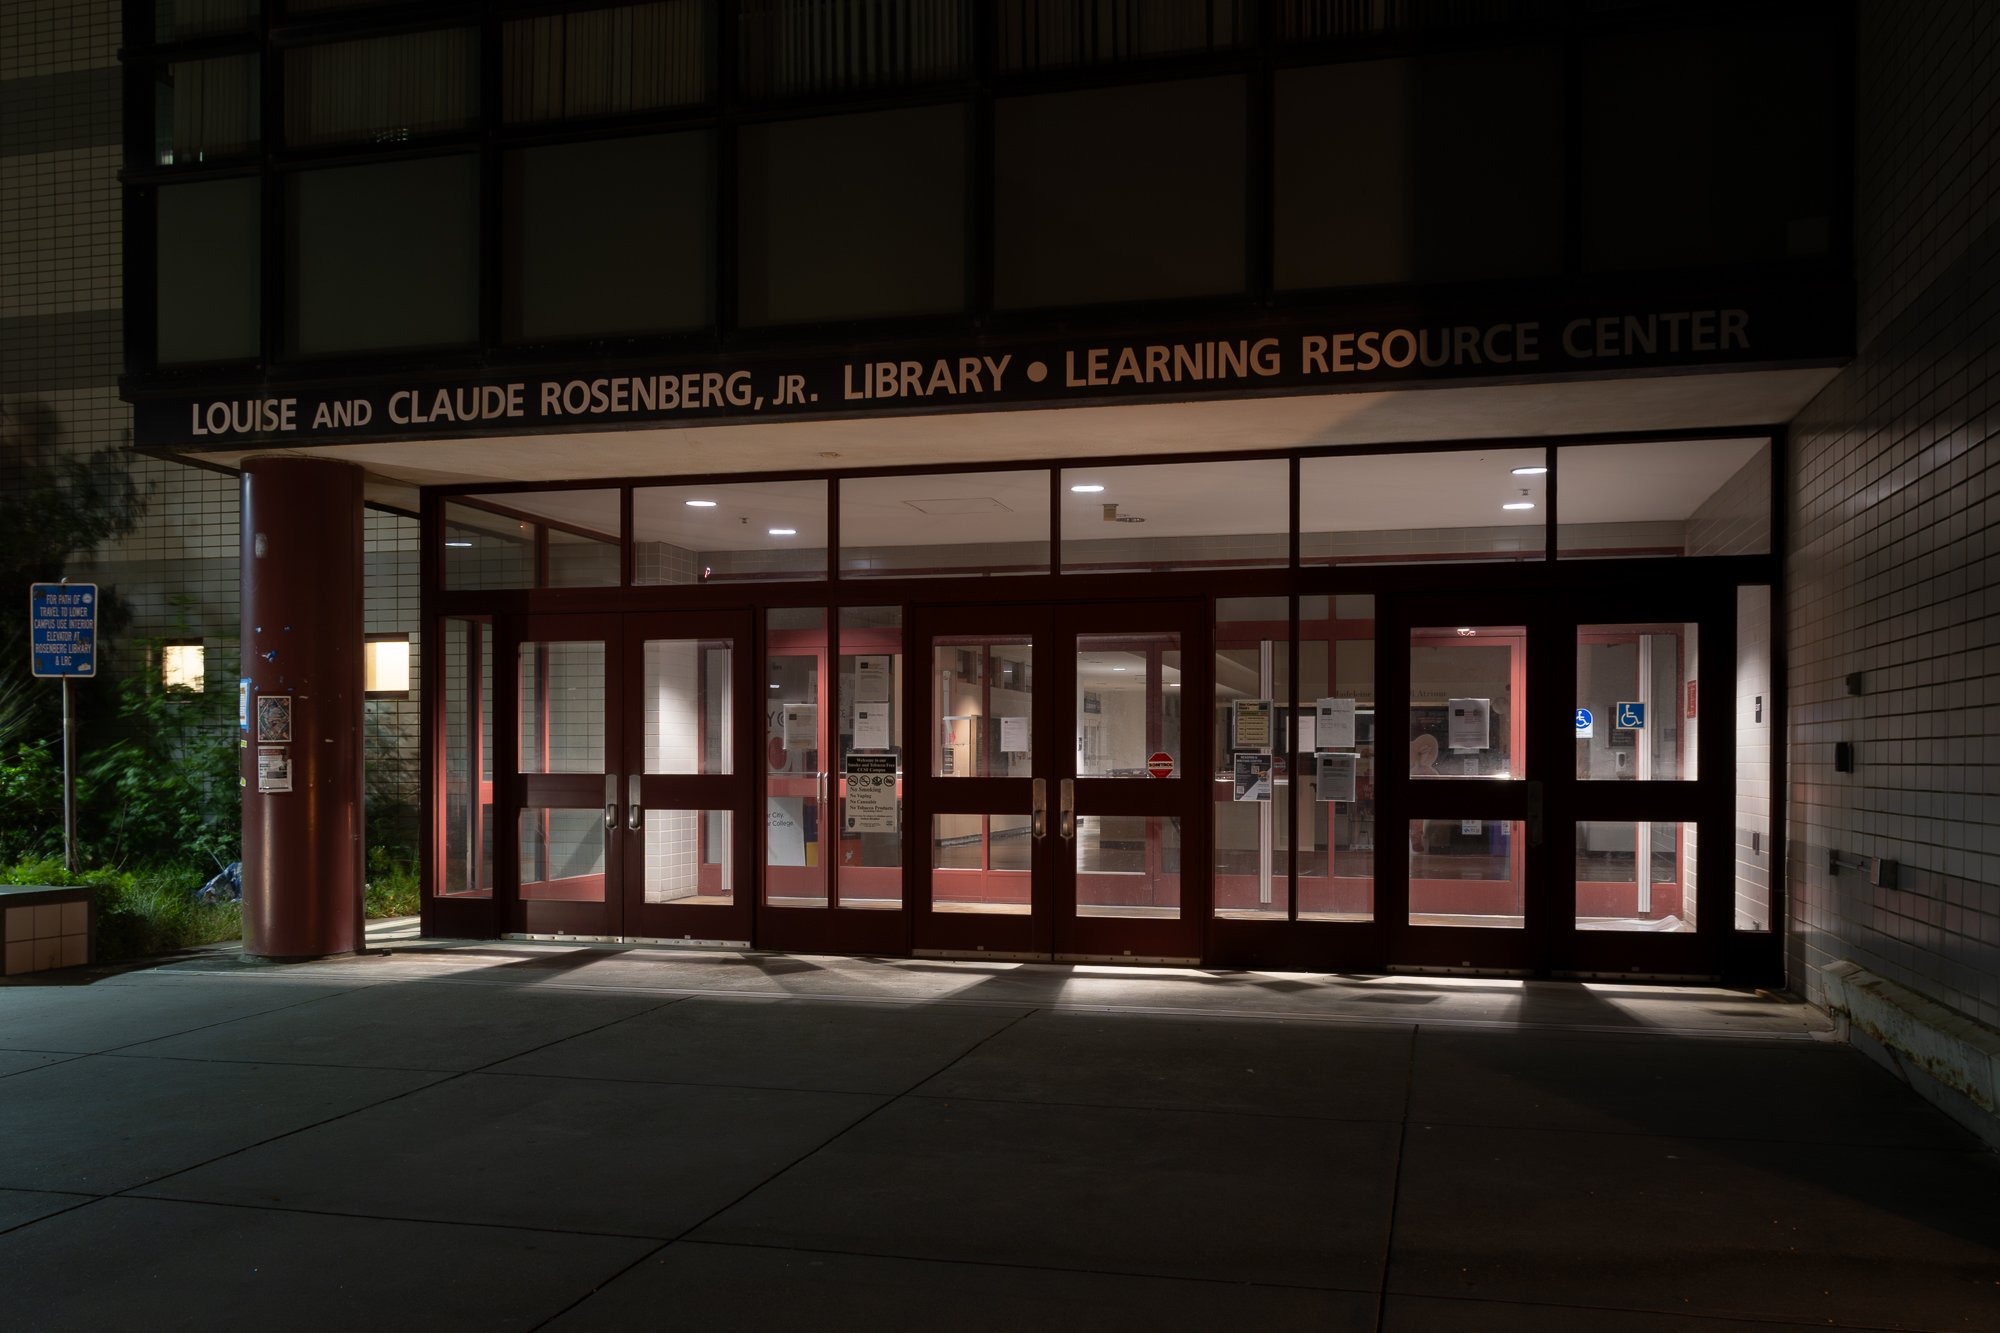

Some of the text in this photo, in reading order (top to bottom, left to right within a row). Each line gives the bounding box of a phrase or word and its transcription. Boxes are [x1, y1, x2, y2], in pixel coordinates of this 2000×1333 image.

[191, 308, 1751, 435] LOUISE AND CLAUDE ROSENBERG, JR. LIBRARY LEARNING RESOURCE CENTER
[46, 594, 81, 605] FOR PATH OF
[40, 606, 88, 617] TRAVEL TO LOWER
[34, 619, 94, 629] CAMPUS USE INTERIOR
[46, 631, 80, 642] ELEVATOR AT
[35, 643, 91, 654] ROSENBERG LIBRARY
[61, 656, 72, 666] LRC
